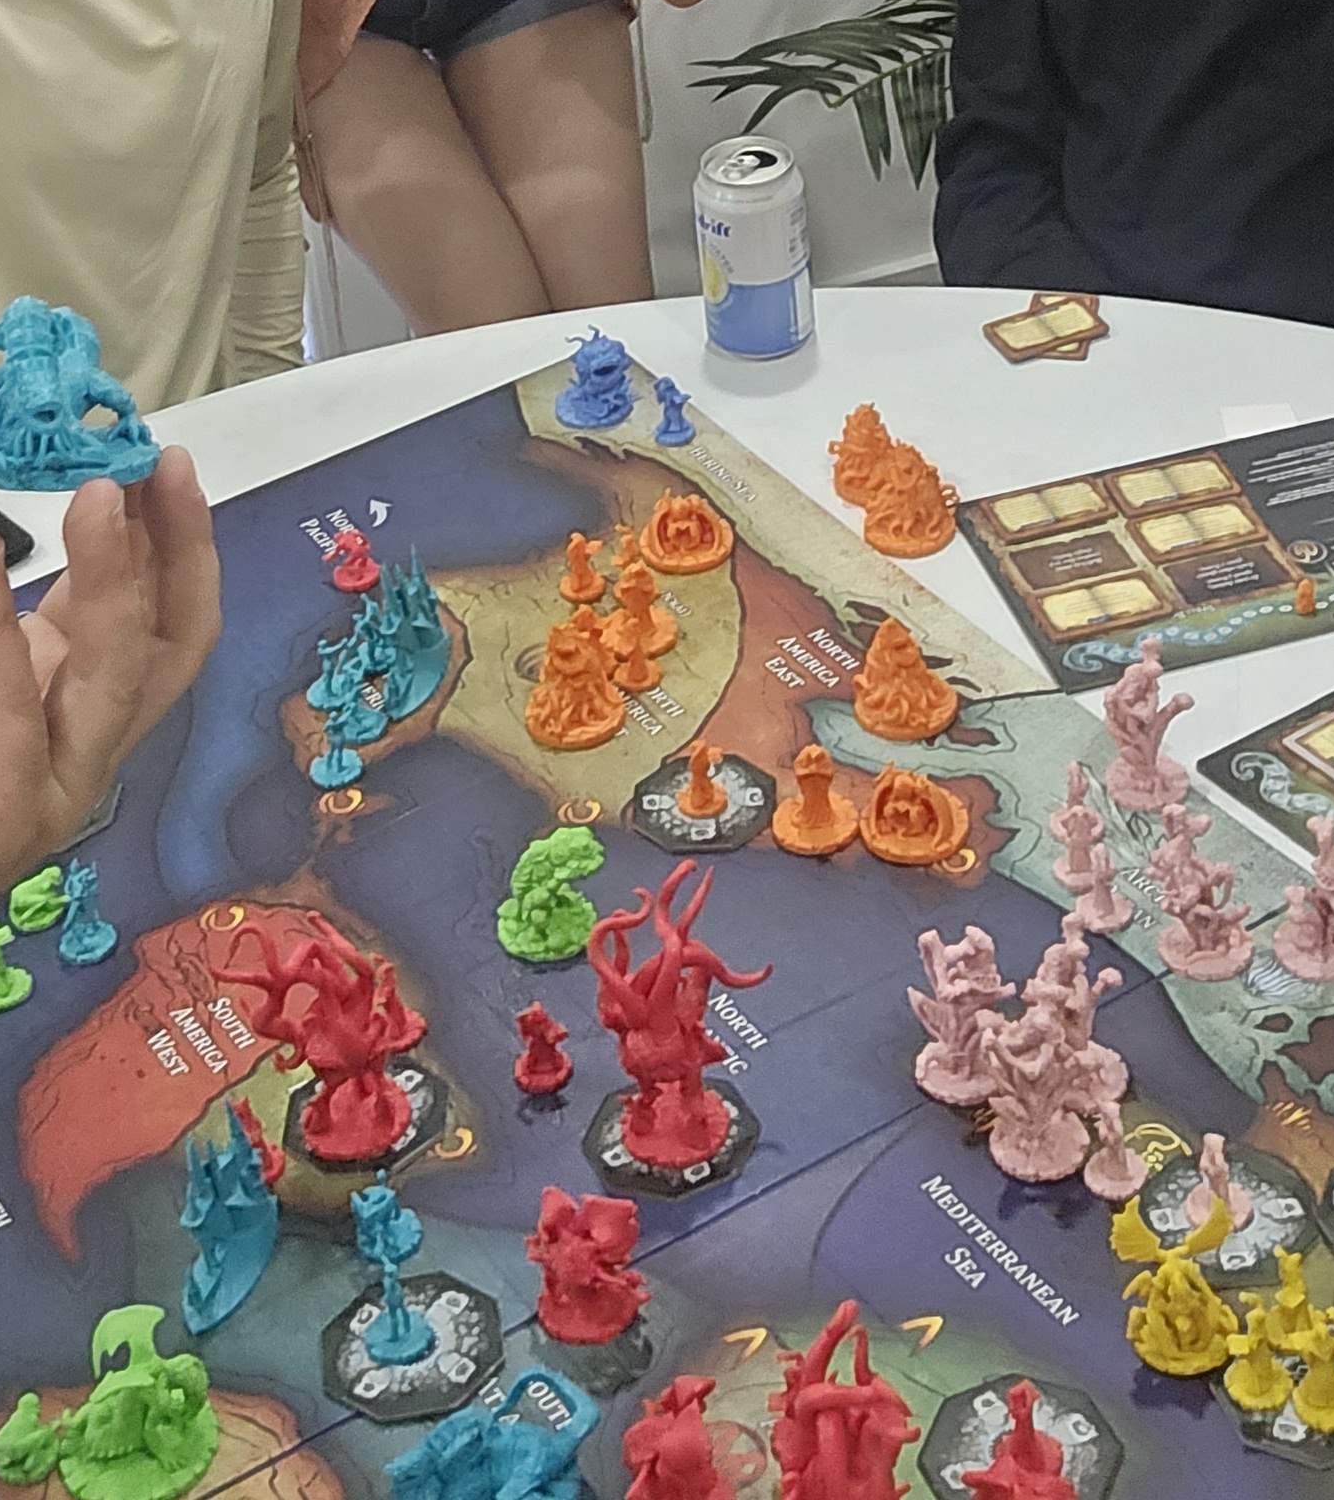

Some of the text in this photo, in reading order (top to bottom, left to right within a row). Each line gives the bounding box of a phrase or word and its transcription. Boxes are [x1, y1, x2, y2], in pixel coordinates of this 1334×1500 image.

[299, 517, 340, 556] PACIFI
[764, 655, 806, 688] EAST
[775, 636, 840, 689] AMERICA
[806, 627, 861, 671] NORTH
[168, 1006, 229, 1074] AMERICA
[207, 996, 256, 1050] SOUTH
[707, 992, 768, 1051] NORTH
[147, 1028, 190, 1077] WEST
[920, 1175, 1080, 1326] MEDITERRANEAN
[944, 1246, 986, 1289] SEA
